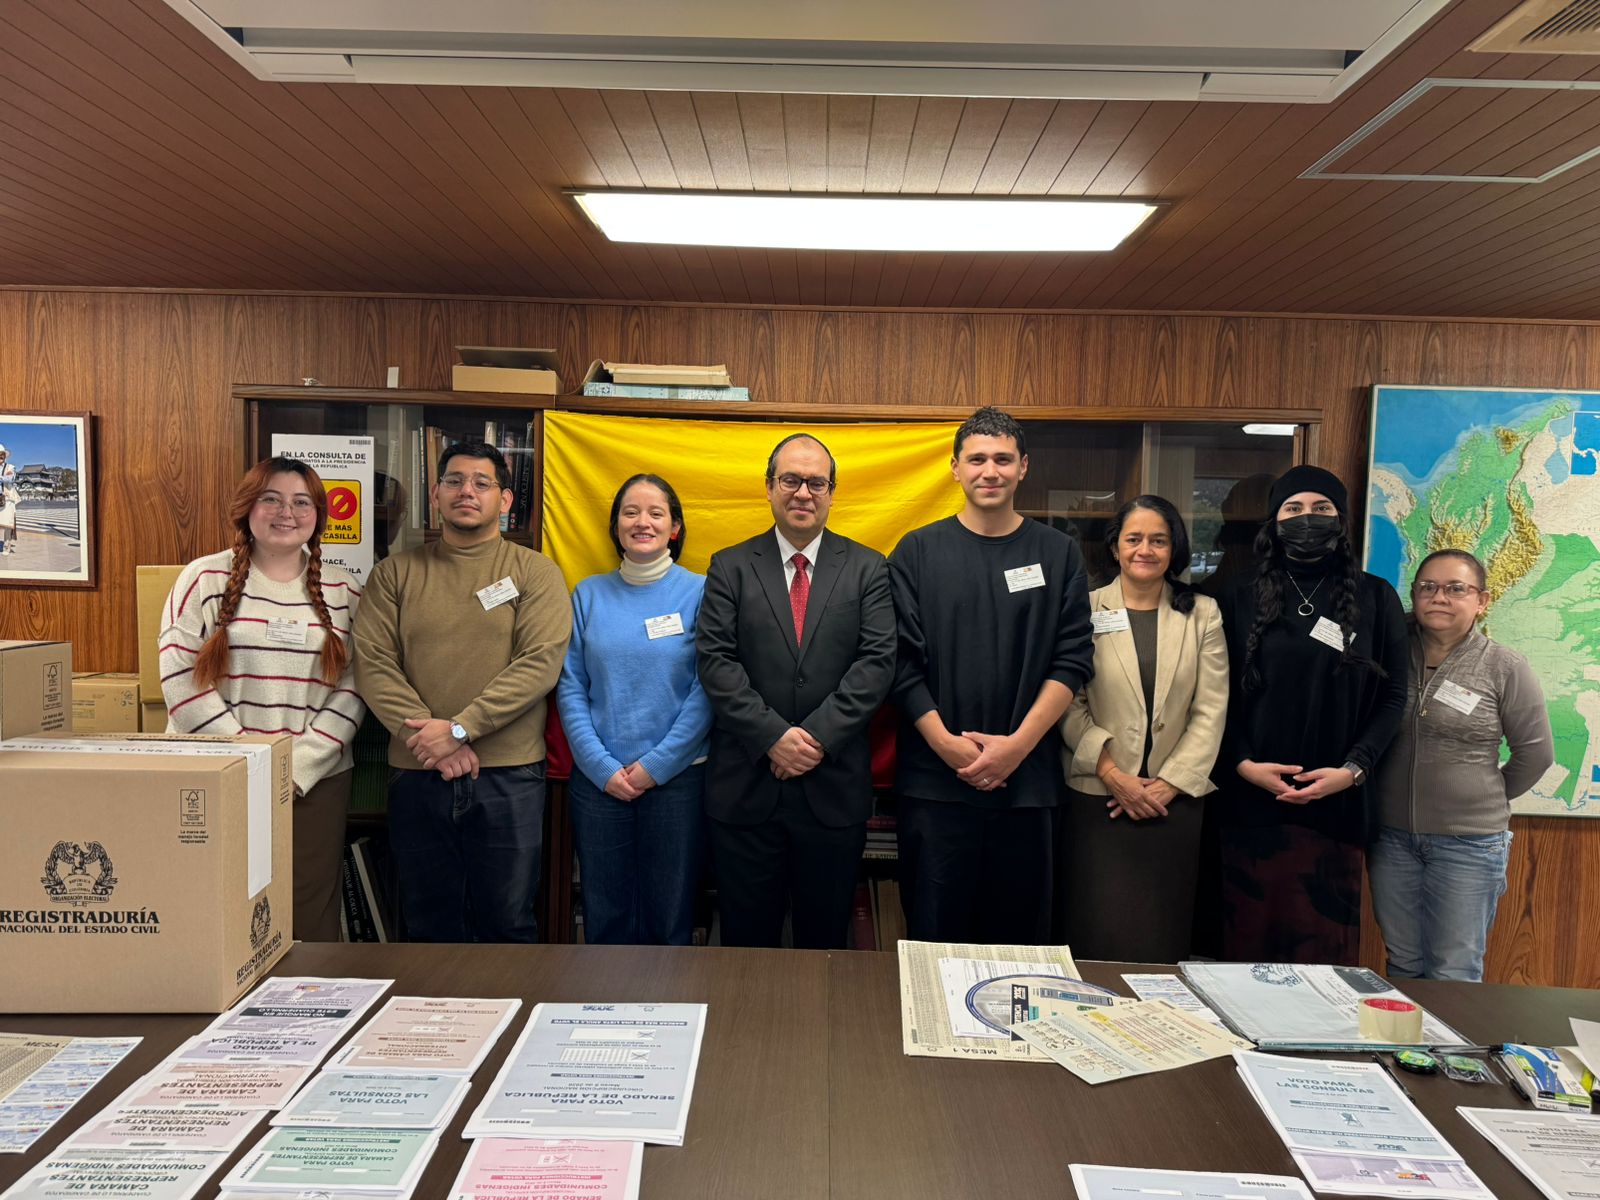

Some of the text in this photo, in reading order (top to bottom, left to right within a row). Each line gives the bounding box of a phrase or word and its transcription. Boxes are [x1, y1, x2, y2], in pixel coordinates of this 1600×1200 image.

[0, 907, 160, 924] REGISTRADURÍA
[0, 924, 160, 934] NACIONAL DEL ESTADO CIVIL
[236, 930, 282, 981] REGISTRADURÍA
[1302, 1084, 1375, 1094] CONSULTAS
[46, 1162, 115, 1170] INDÍGENAS
